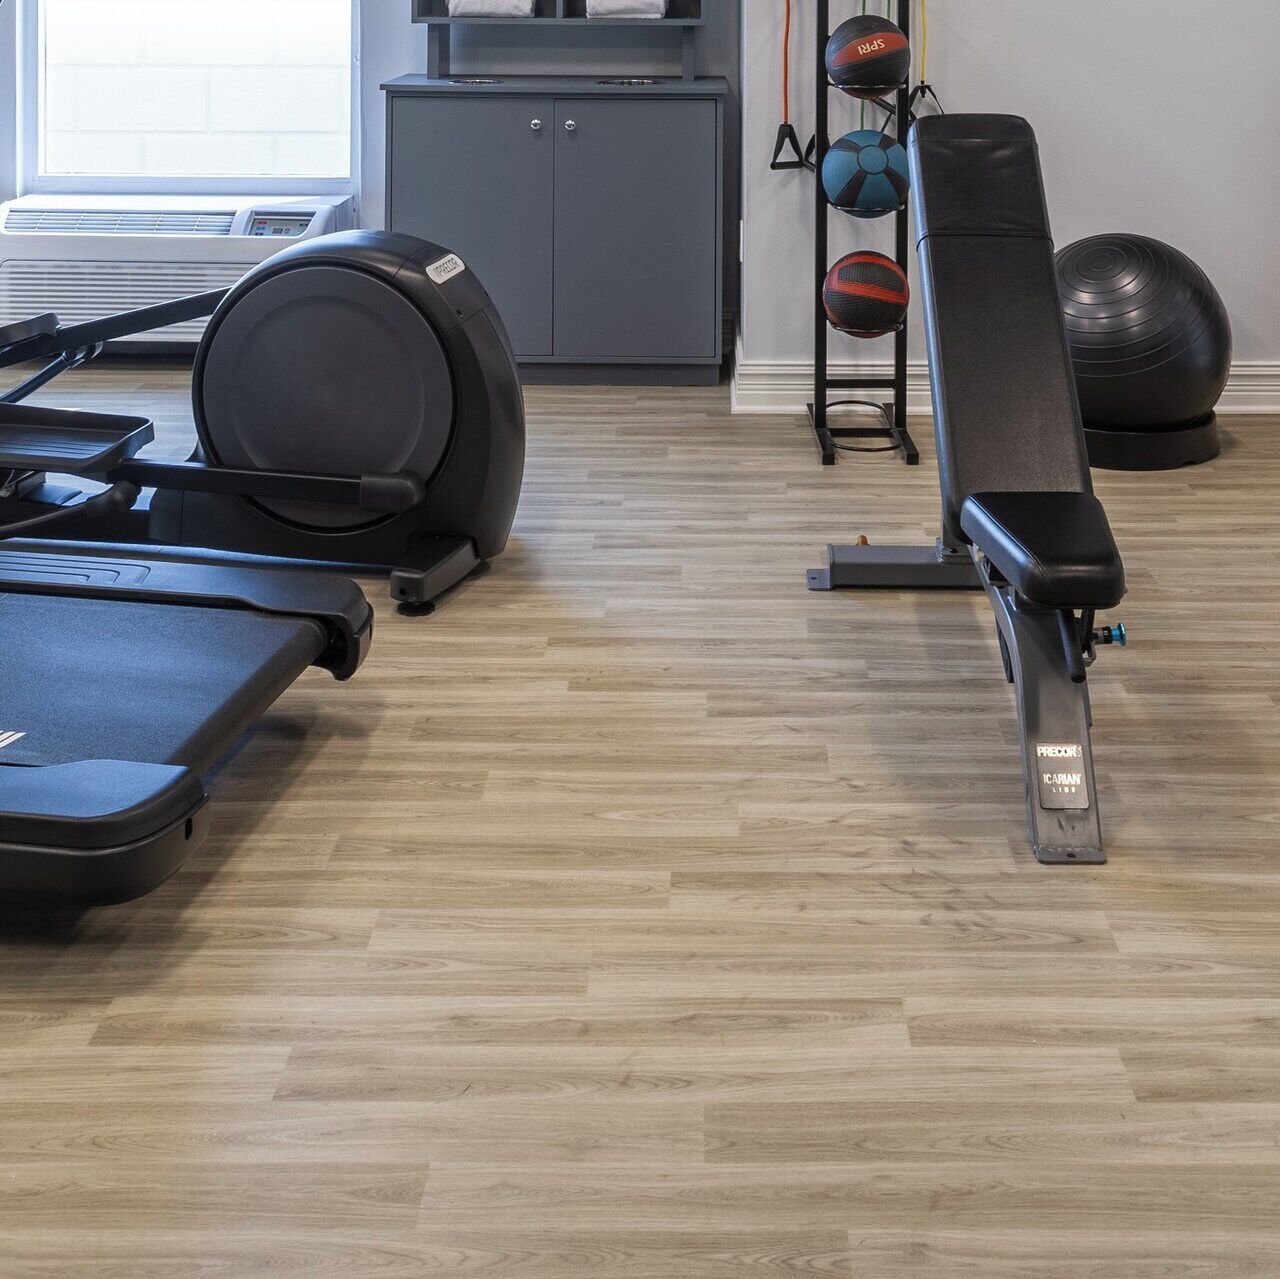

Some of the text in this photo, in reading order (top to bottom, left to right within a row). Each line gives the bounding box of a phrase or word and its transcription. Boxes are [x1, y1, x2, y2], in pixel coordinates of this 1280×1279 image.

[857, 38, 885, 55] SPRI
[1037, 746, 1077, 757] PRECOR
[1043, 773, 1081, 785] ICARIAN
